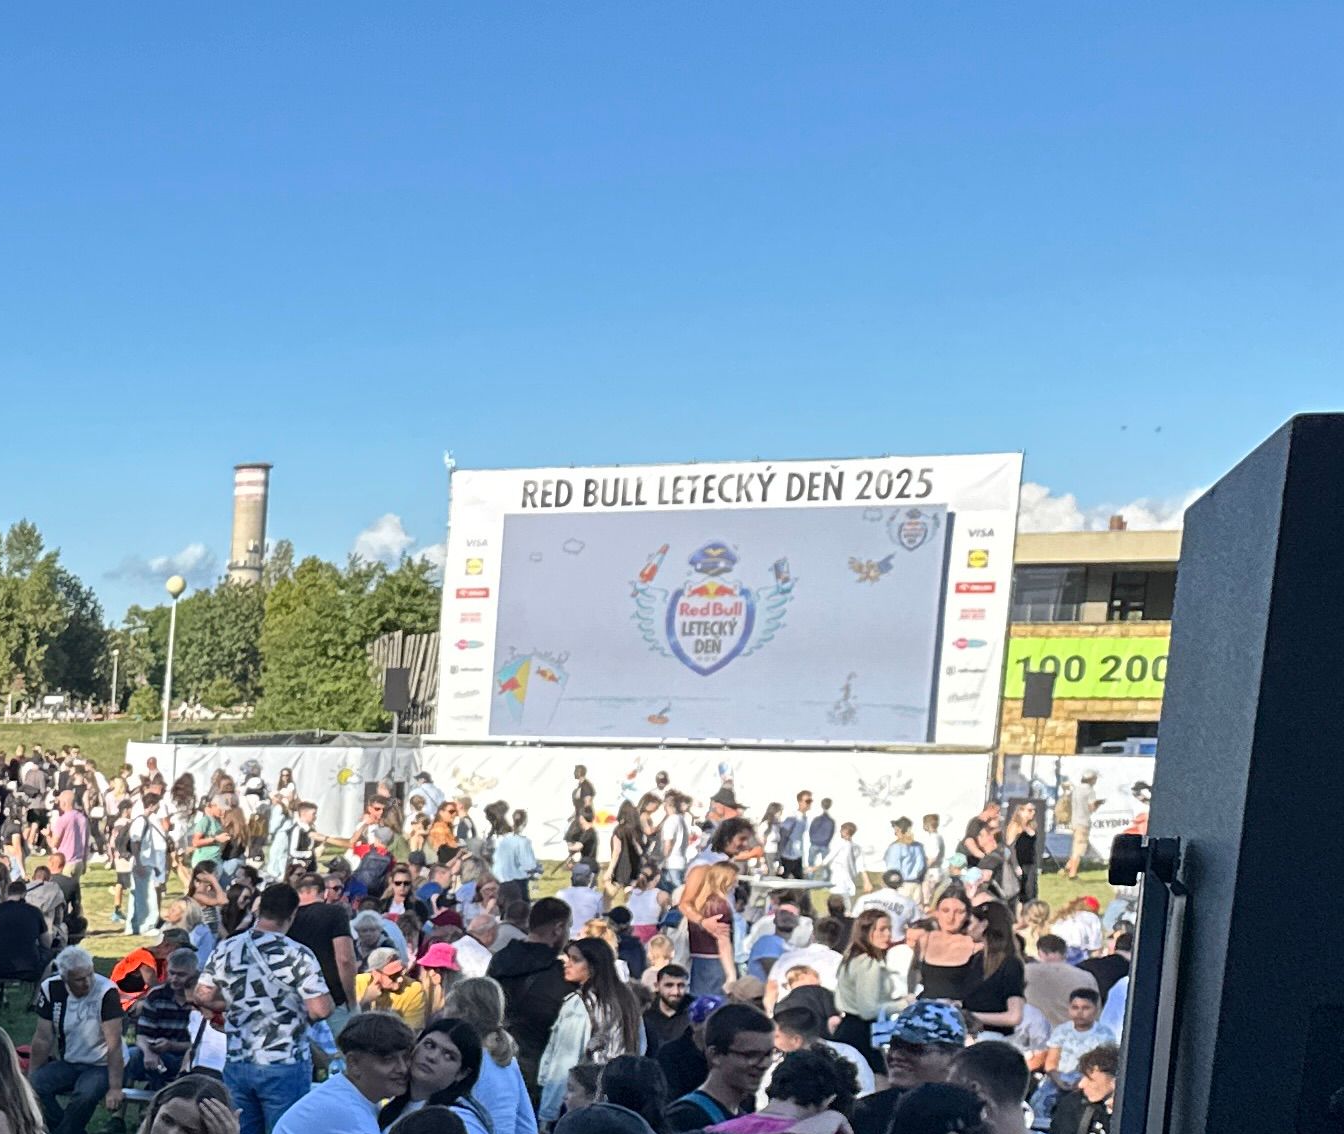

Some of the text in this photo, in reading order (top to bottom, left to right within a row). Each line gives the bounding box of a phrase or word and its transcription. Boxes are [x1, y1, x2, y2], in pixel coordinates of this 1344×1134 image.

[521, 464, 934, 508] RED BULL LETECKÝ DEŇ 2025
[968, 528, 995, 537] VISA
[679, 601, 742, 616] Red Bull
[681, 617, 738, 636] LETECKÝ
